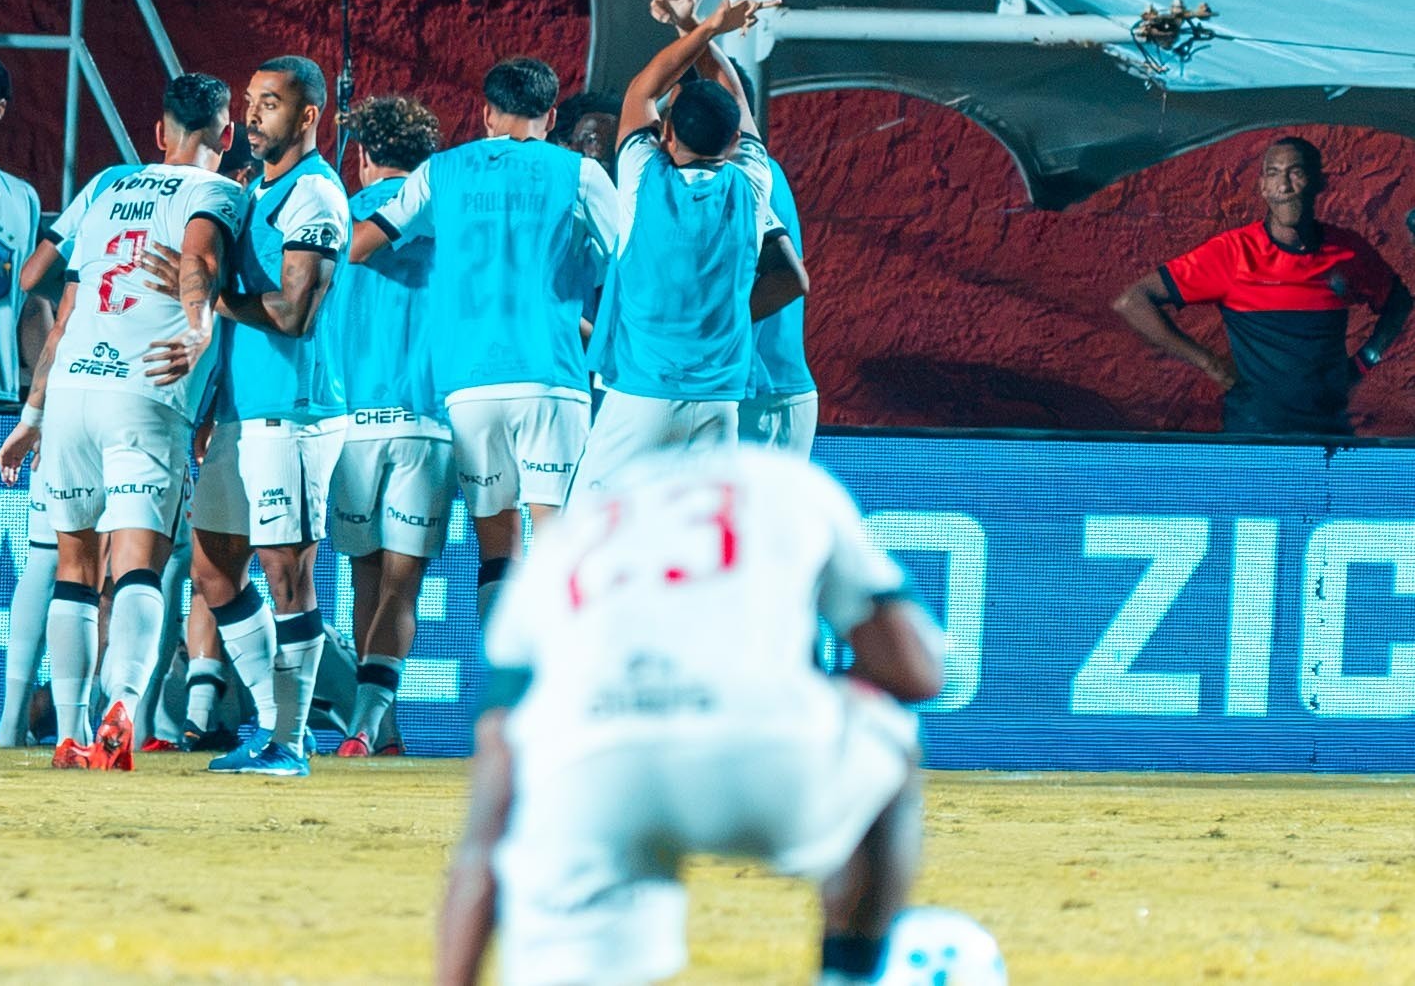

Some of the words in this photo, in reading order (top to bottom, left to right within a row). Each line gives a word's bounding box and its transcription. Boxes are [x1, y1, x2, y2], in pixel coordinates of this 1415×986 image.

[109, 201, 155, 221] PUMA
[96, 227, 152, 315] 2
[69, 362, 130, 378] CHEFE
[354, 410, 417, 425] CHEFE
